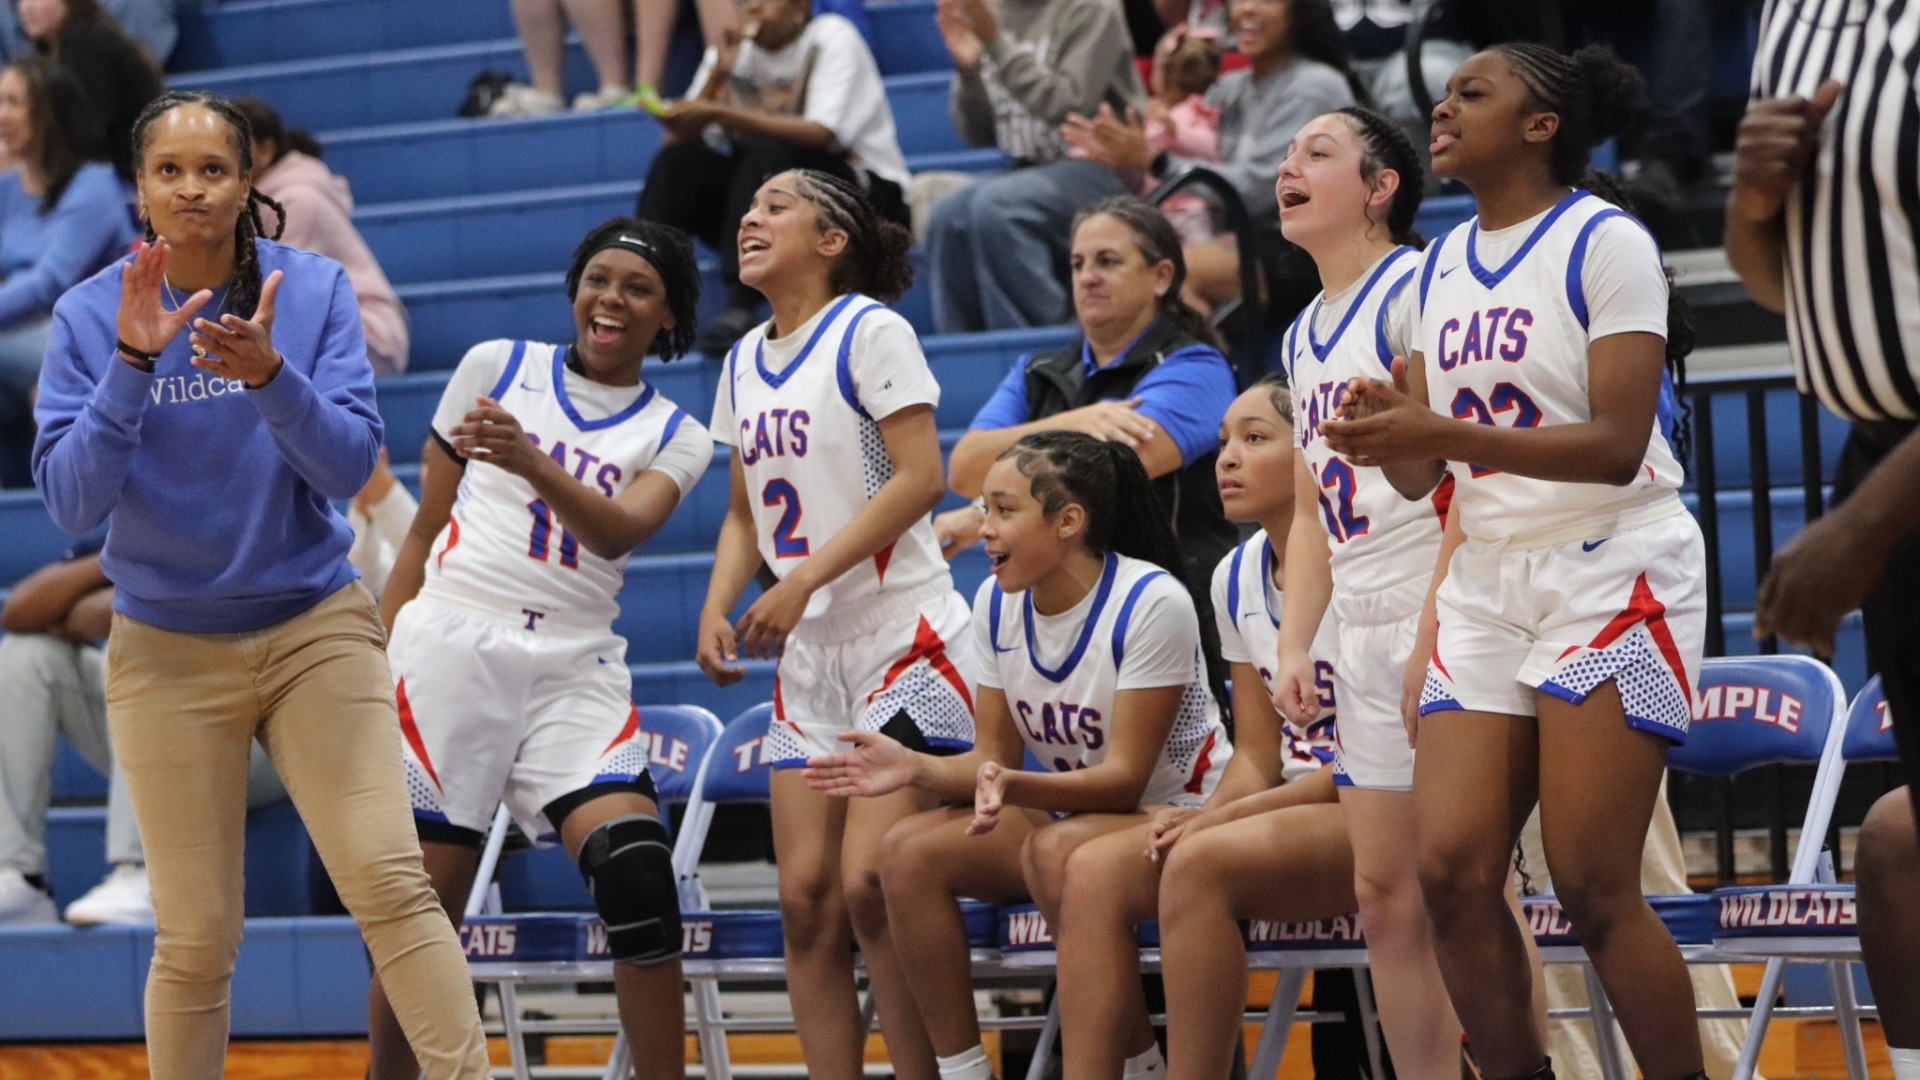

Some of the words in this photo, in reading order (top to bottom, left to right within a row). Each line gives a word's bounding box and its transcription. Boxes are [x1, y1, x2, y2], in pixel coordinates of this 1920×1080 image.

[1438, 306, 1535, 372] CATS
[740, 408, 811, 467] CATS
[762, 477, 810, 559] 2
[1311, 455, 1370, 544] 12
[521, 608, 545, 631] T
[1016, 700, 1104, 750] CATS
[1691, 684, 1802, 735] MPLE
[1719, 889, 1858, 929] WILDCATS
